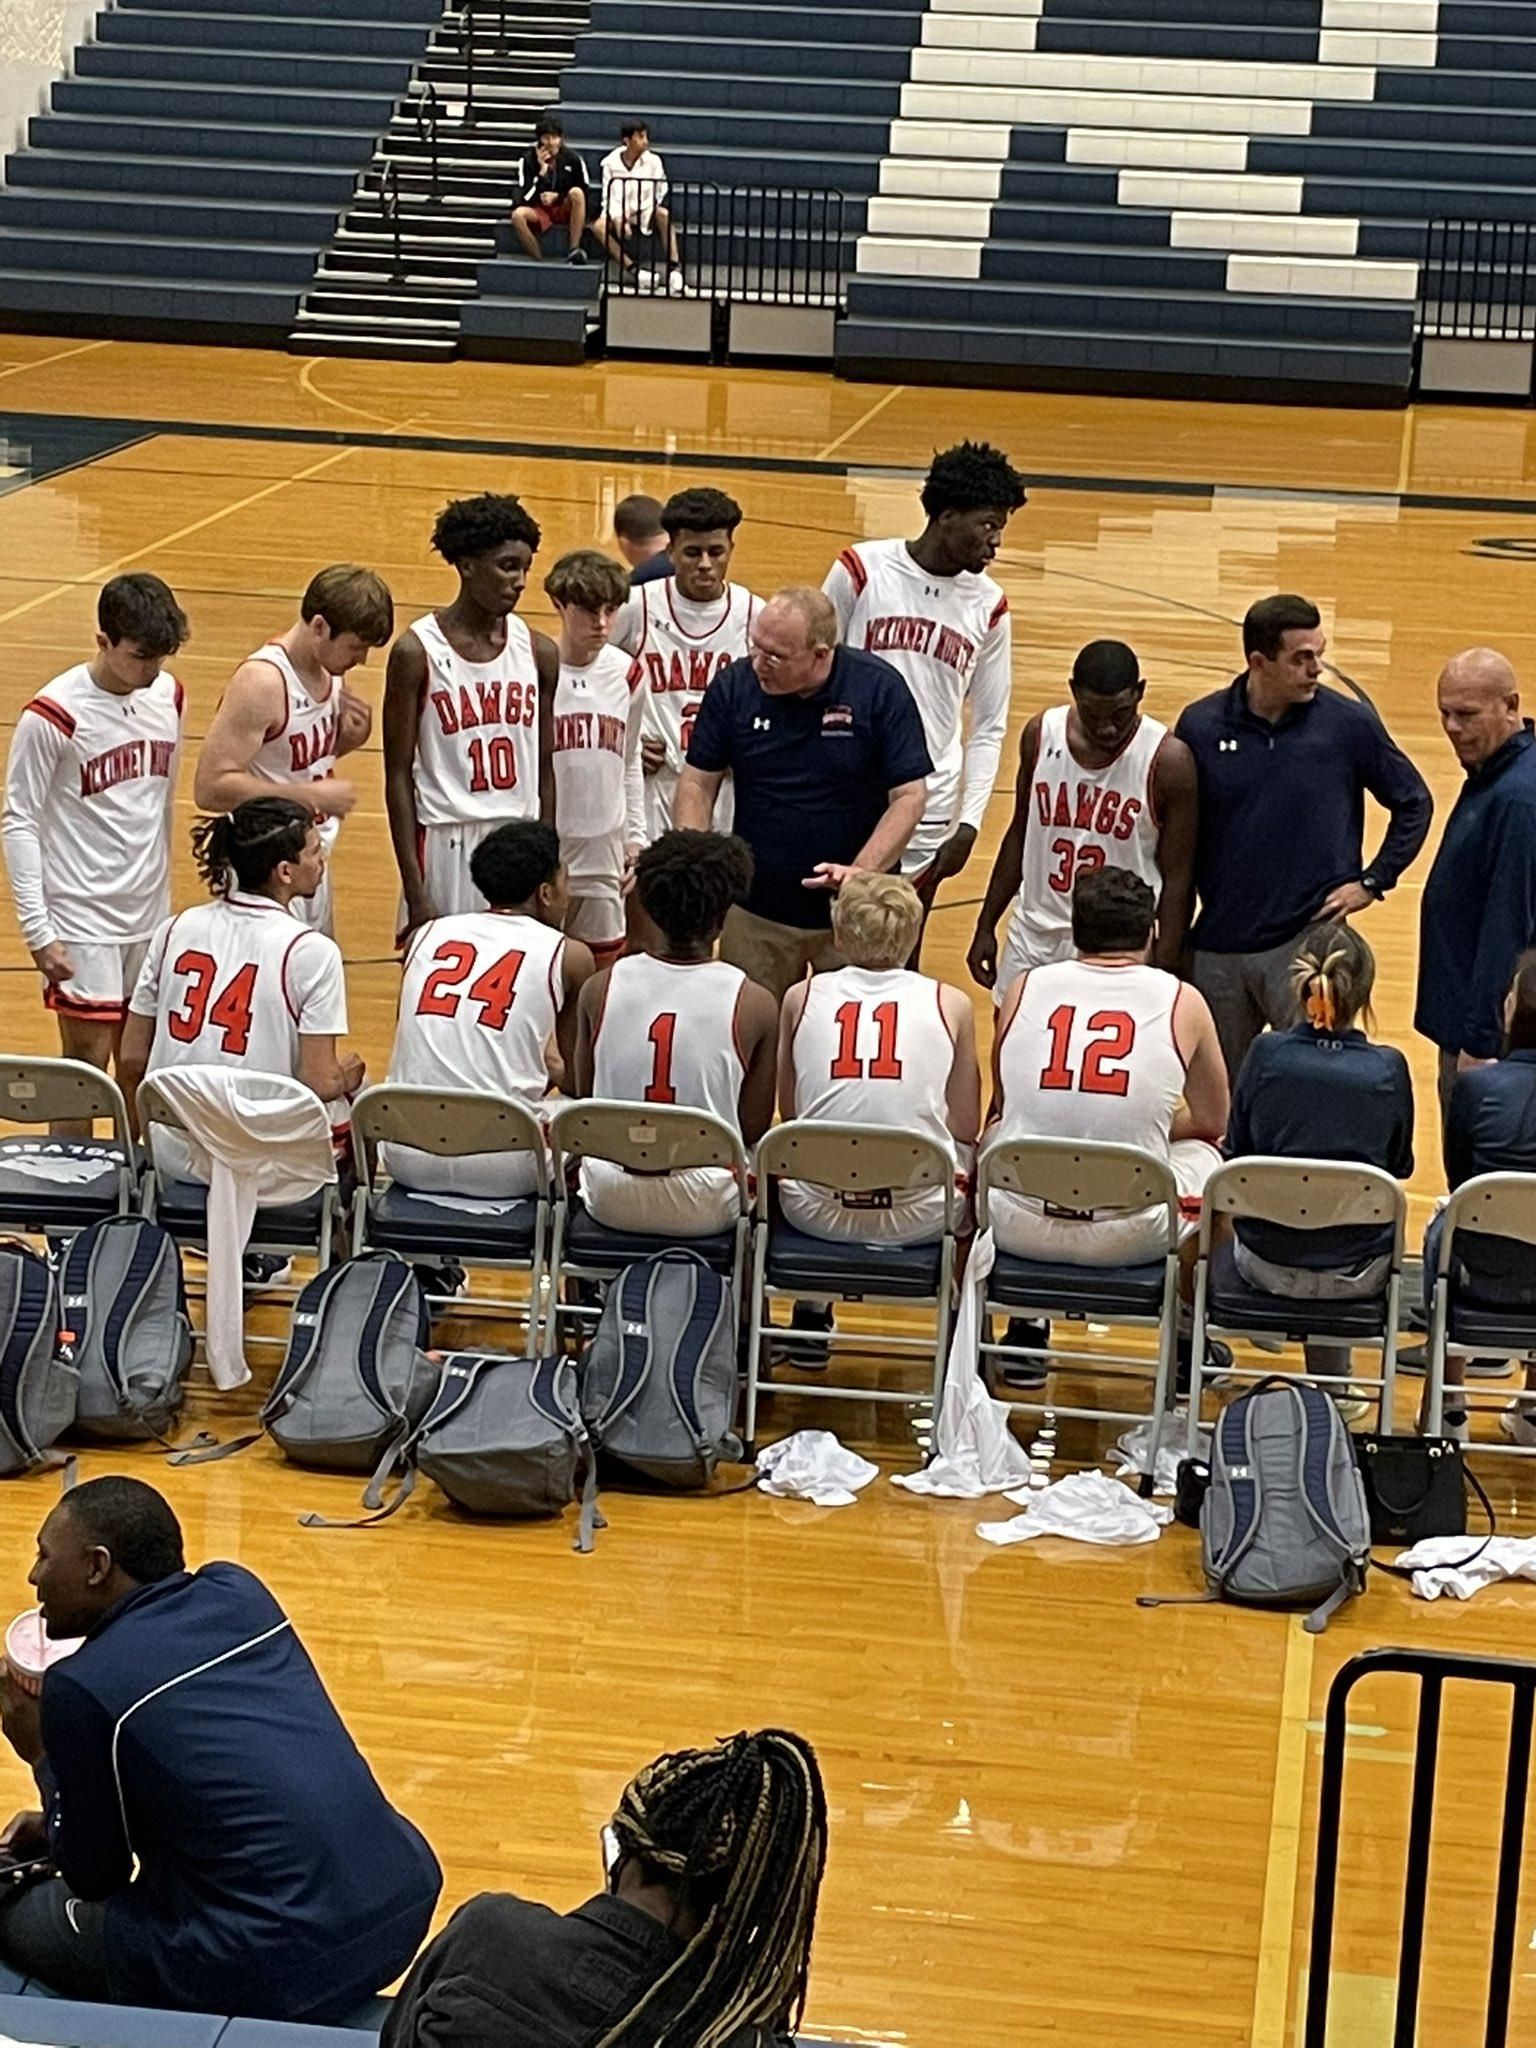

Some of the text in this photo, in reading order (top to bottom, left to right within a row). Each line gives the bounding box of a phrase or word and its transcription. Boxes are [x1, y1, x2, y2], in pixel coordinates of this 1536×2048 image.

[429, 680, 537, 736] DAWGS
[468, 736, 517, 792] 10
[1035, 781, 1141, 841] DAWGS
[168, 949, 260, 1057] 34
[415, 940, 526, 1032] 24
[644, 1013, 677, 1102] 1
[831, 1002, 903, 1080] 11
[1040, 1004, 1136, 1097] 12
